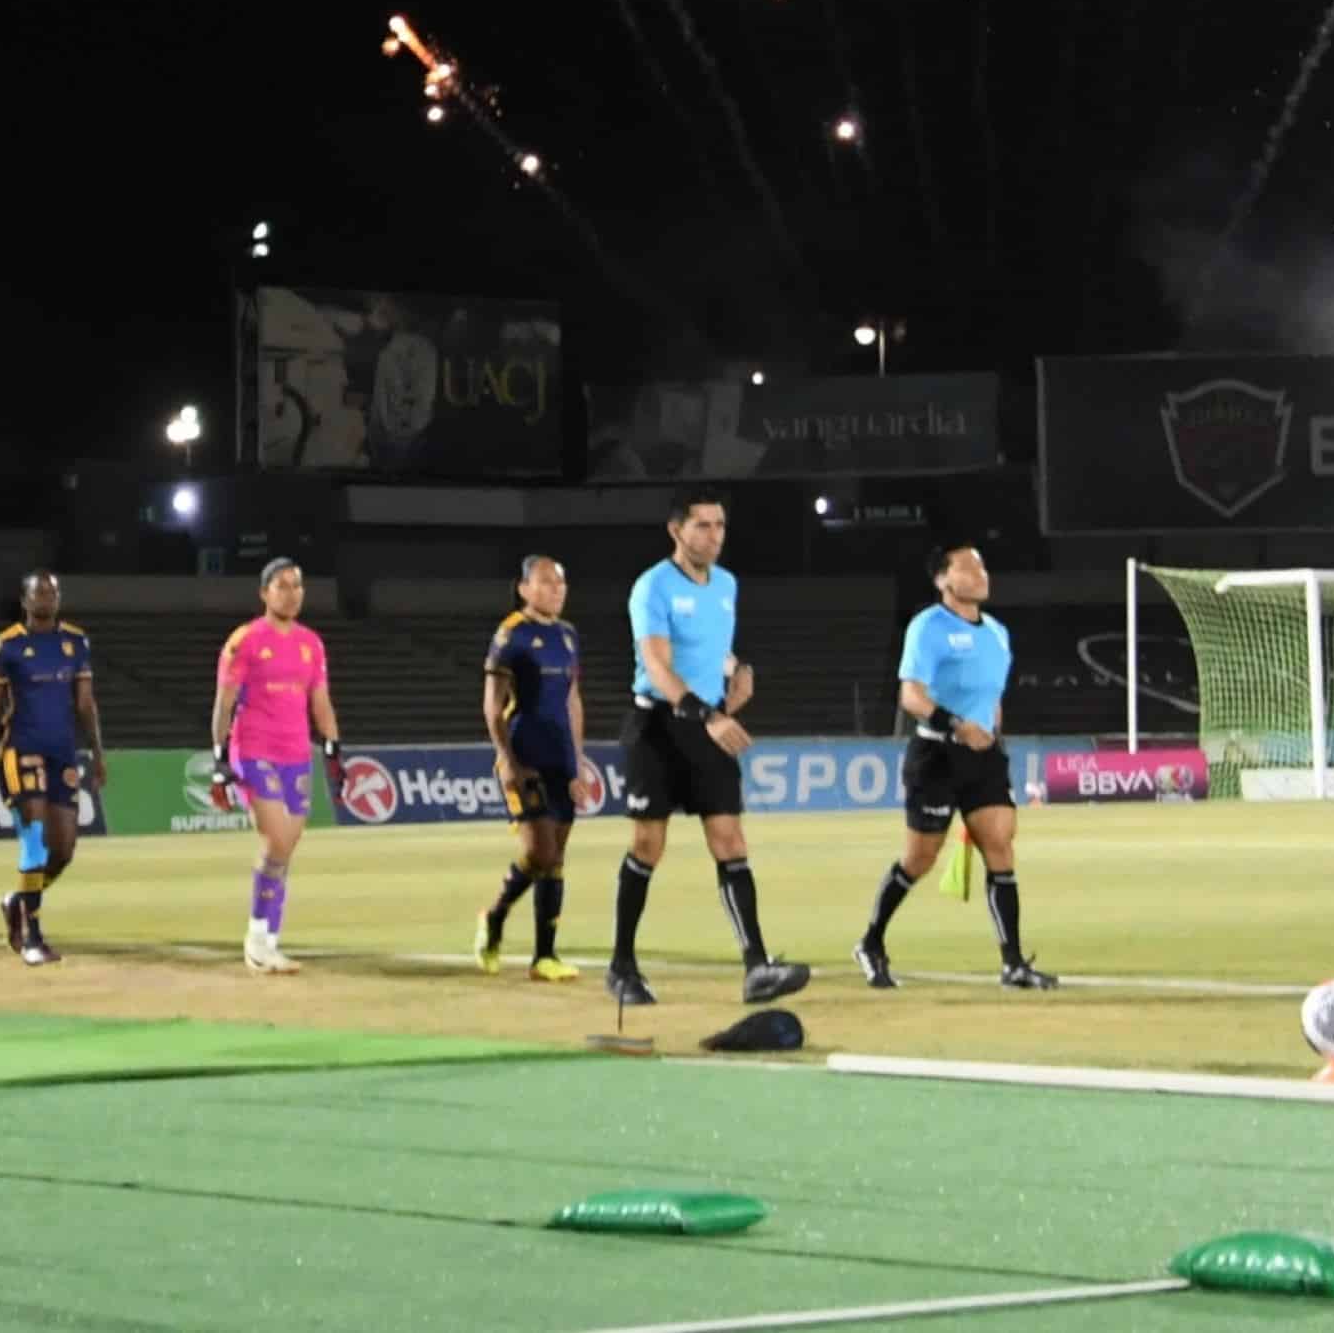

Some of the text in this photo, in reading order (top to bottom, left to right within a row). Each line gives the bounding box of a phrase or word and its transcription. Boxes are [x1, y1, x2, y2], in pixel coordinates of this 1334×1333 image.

[442, 358, 546, 424] UACJ
[1056, 755, 1098, 771] LIGA
[1078, 767, 1154, 795] BBVA
